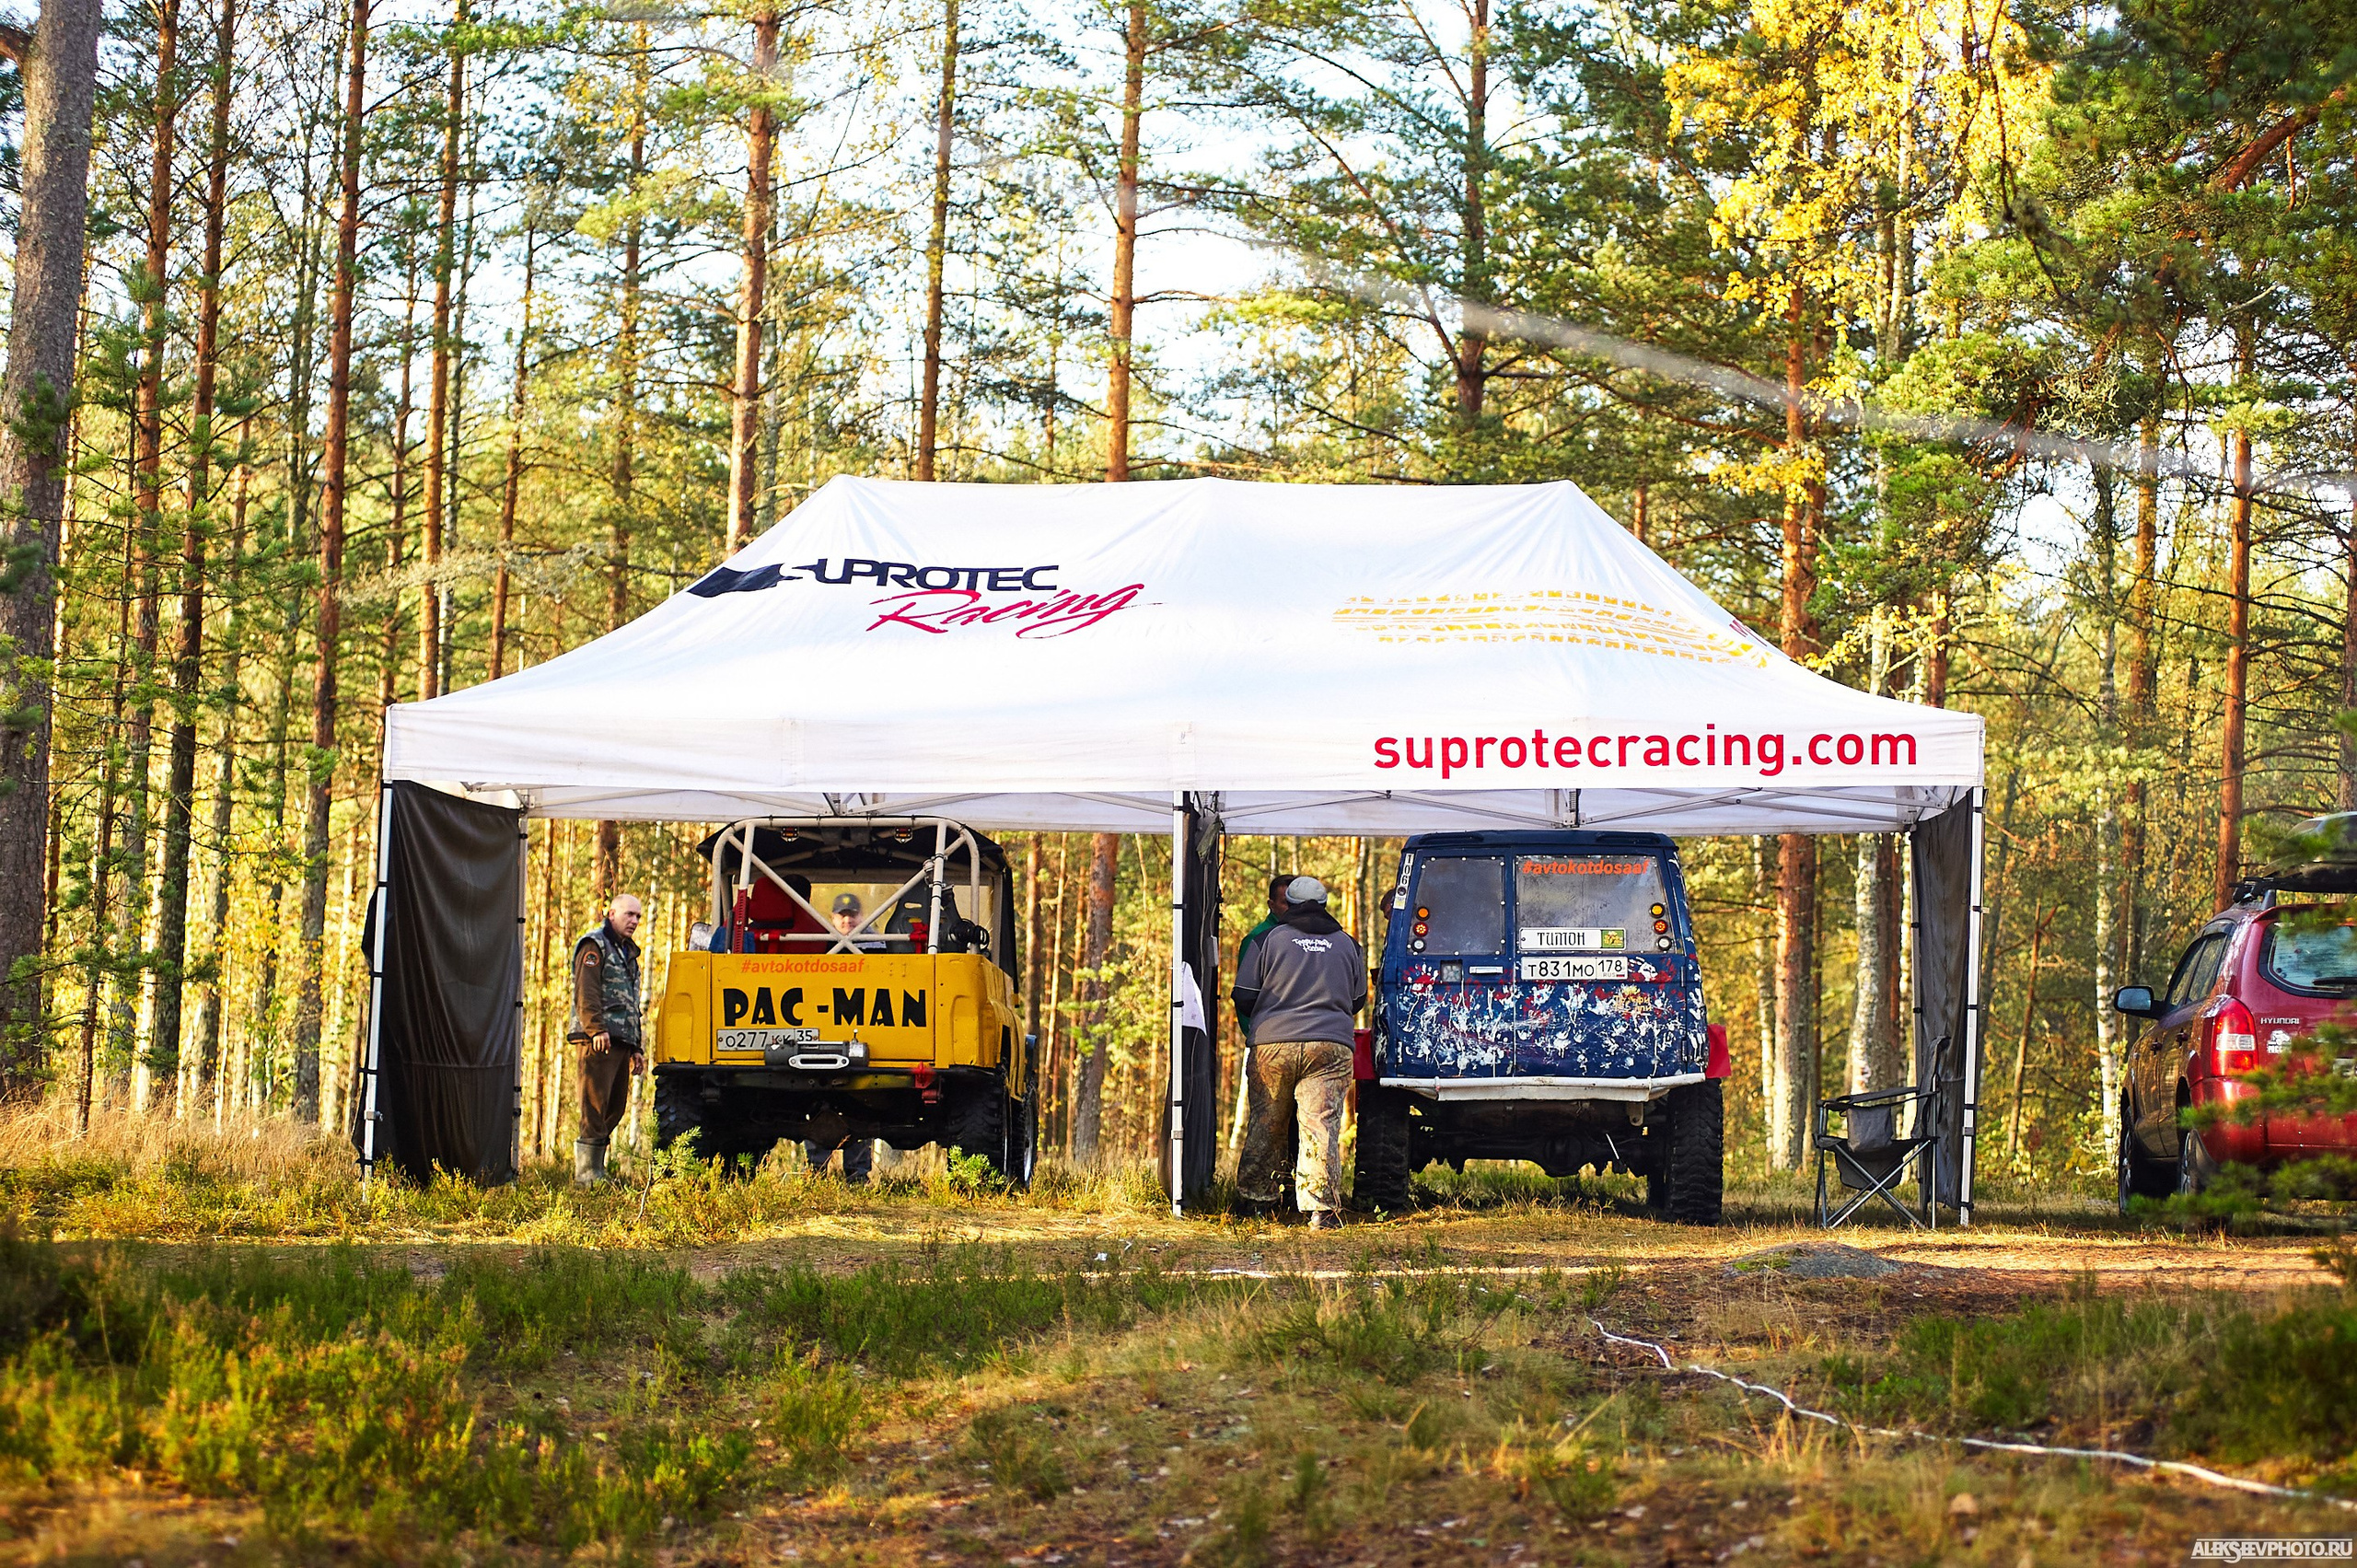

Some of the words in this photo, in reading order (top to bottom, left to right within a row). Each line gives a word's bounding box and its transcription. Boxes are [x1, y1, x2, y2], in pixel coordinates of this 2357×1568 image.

[865, 583, 1155, 639] Racing
[1373, 724, 1918, 779] suprotecracing.com
[1521, 860, 1651, 875] #avtokotdosaaf
[740, 958, 866, 974] #avtokotdosaaf
[1597, 959, 1622, 972] 178
[796, 1029, 814, 1042] 35
